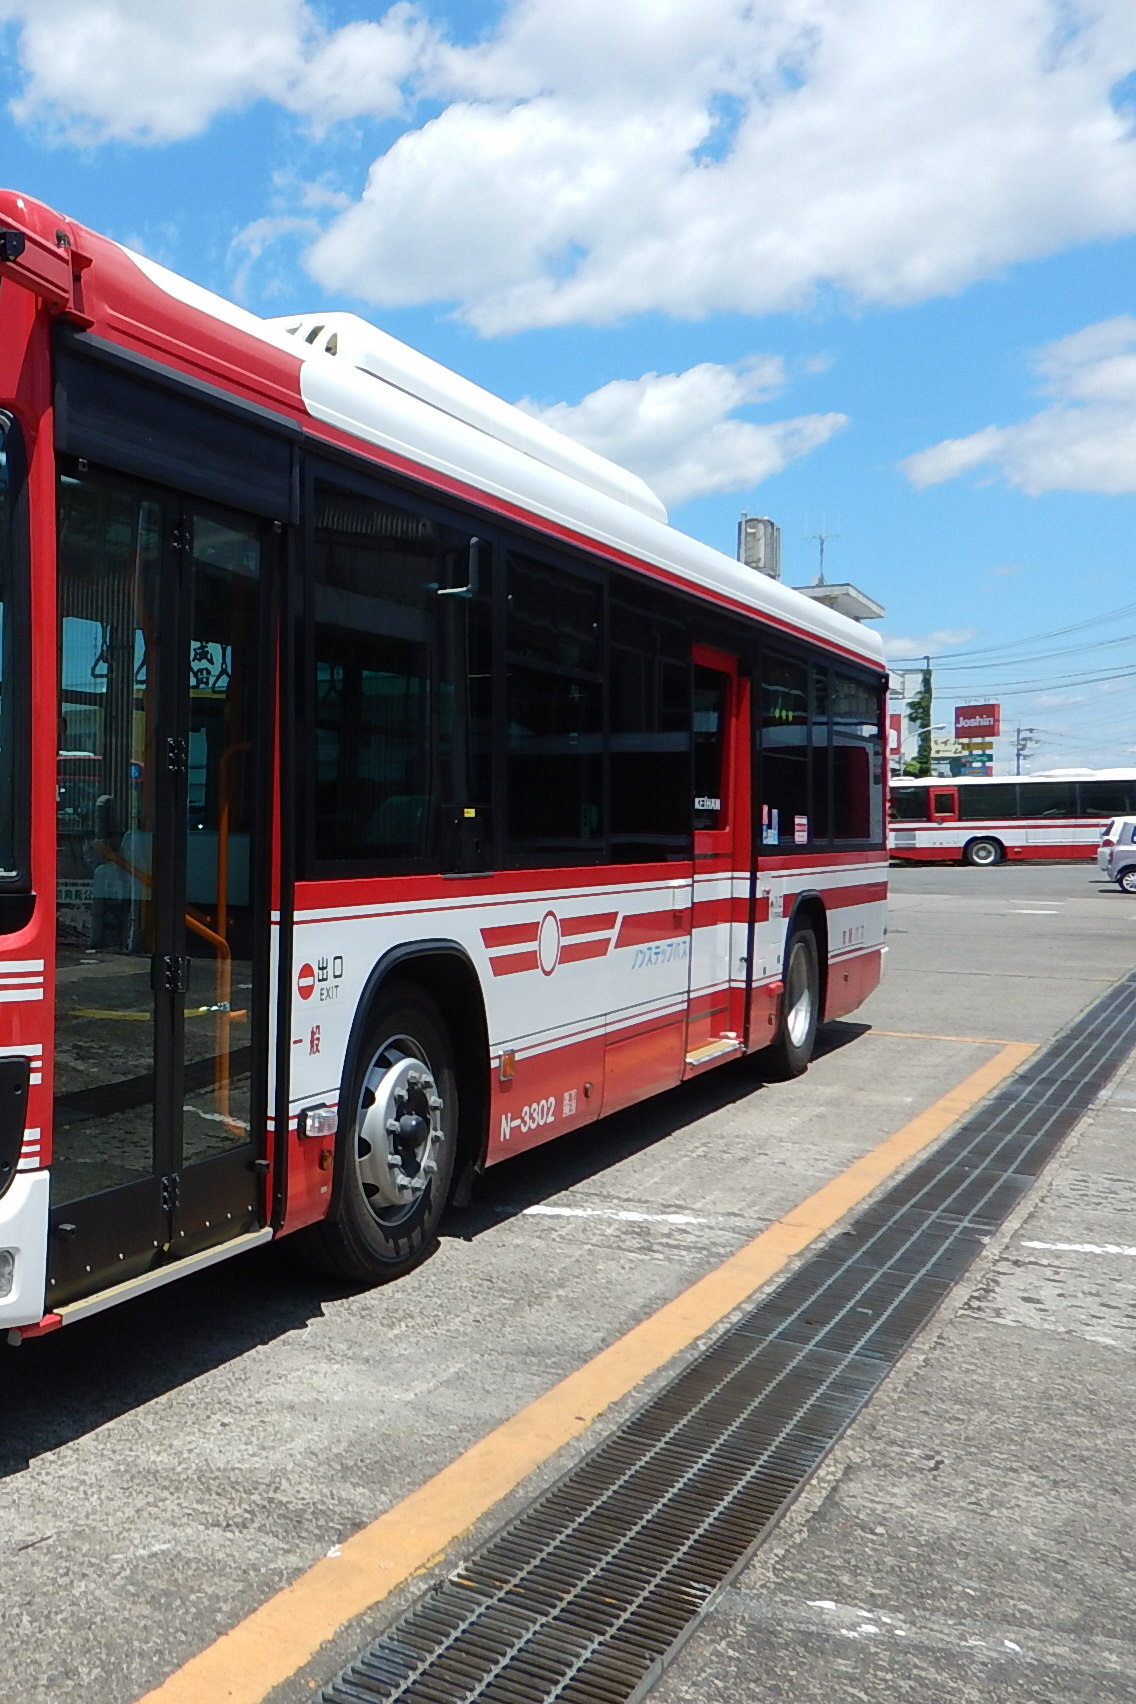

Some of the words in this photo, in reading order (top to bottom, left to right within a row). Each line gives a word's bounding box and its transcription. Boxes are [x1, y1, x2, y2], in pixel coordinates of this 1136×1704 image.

[955, 714, 994, 728] Joshin
[317, 955, 343, 983] 出口
[319, 984, 340, 1001] EXIT
[500, 1095, 556, 1142] N-3302
